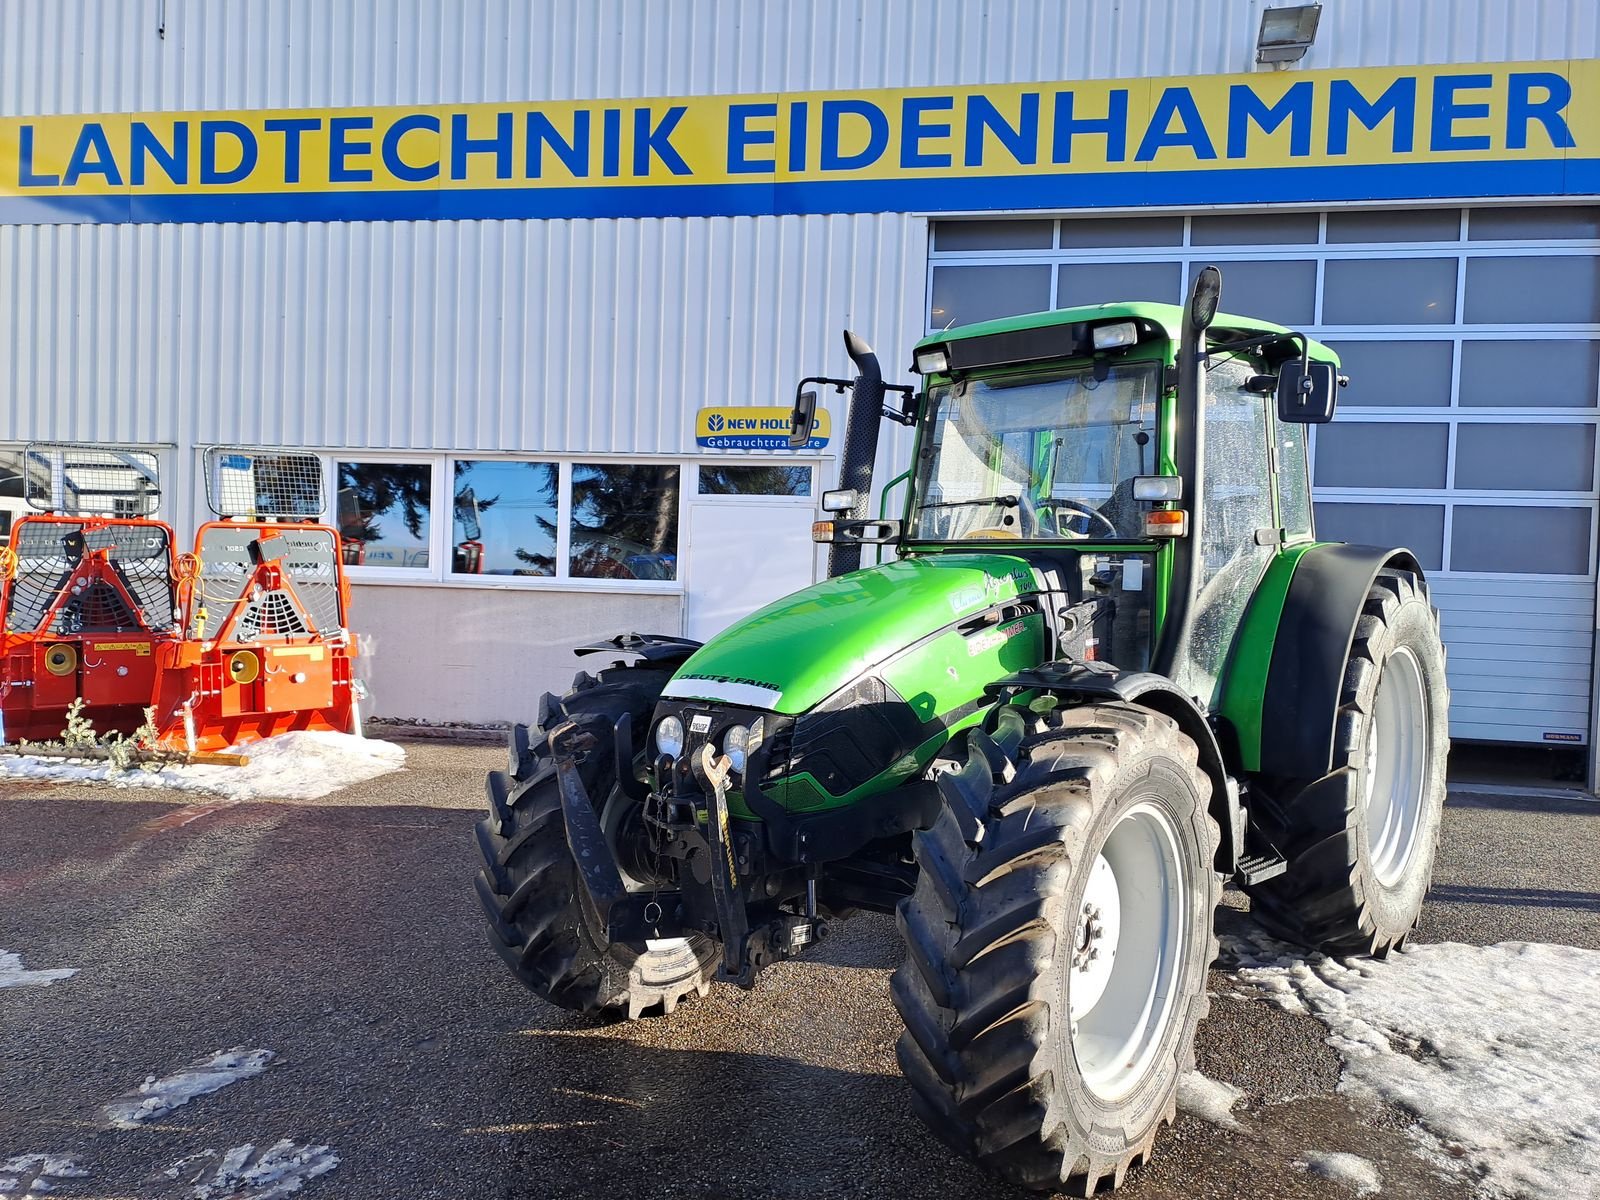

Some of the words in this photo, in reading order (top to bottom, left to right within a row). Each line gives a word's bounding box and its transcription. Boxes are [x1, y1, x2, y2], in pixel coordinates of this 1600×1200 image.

[19, 105, 694, 188] LANDTECHNIK
[726, 71, 1577, 175] EIDENHAMMER
[727, 418, 757, 430] NEW
[760, 418, 820, 430] HOLLD
